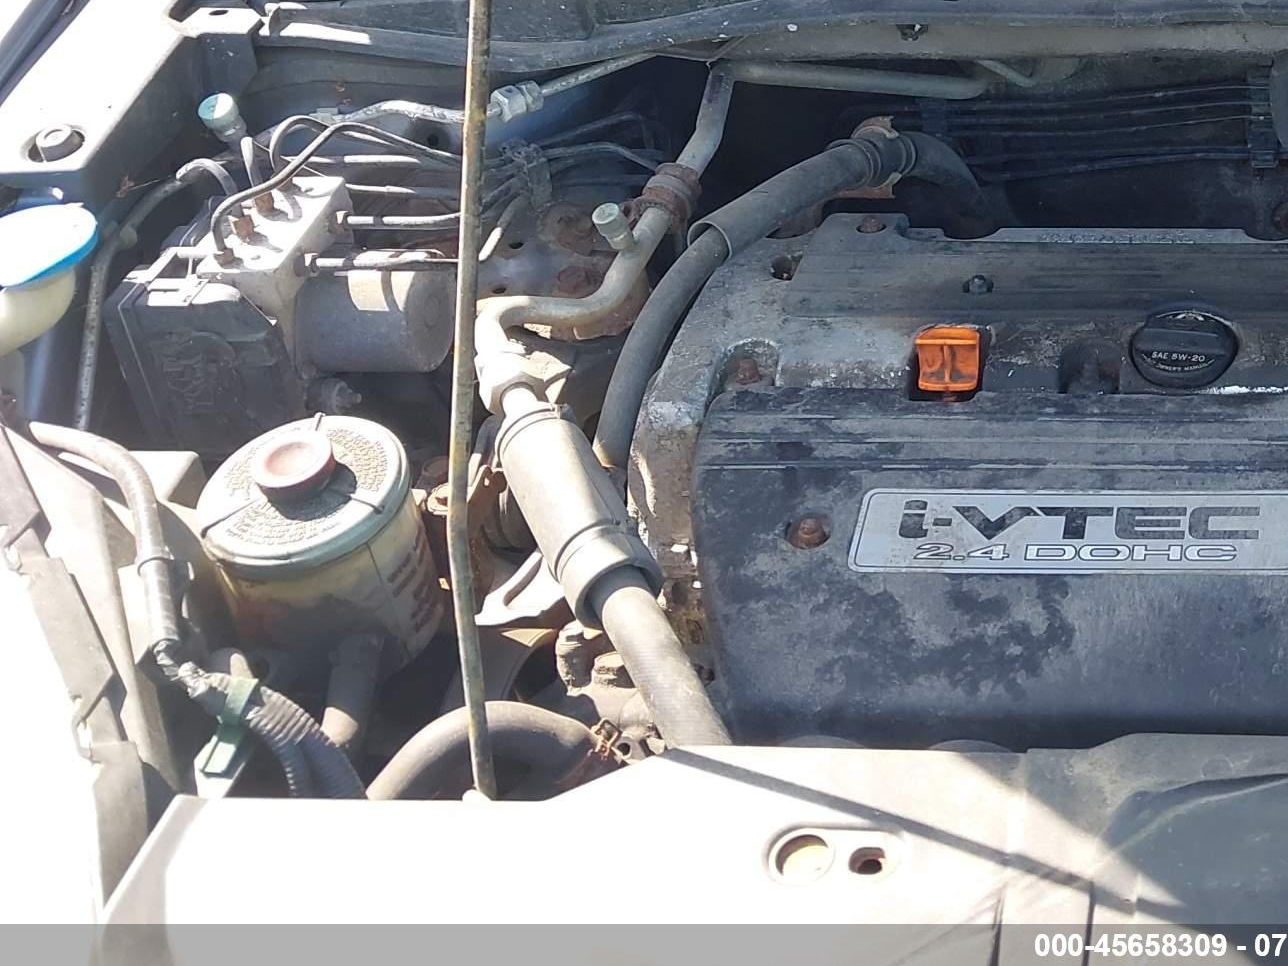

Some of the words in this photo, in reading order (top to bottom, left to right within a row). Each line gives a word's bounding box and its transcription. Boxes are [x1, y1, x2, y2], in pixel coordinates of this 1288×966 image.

[1151, 351, 1168, 359] SAE
[1171, 353, 1206, 362] 5W-20
[899, 499, 1261, 539] i-VTEC
[913, 543, 1010, 561] 2.4
[1023, 544, 1237, 562] DOHC
